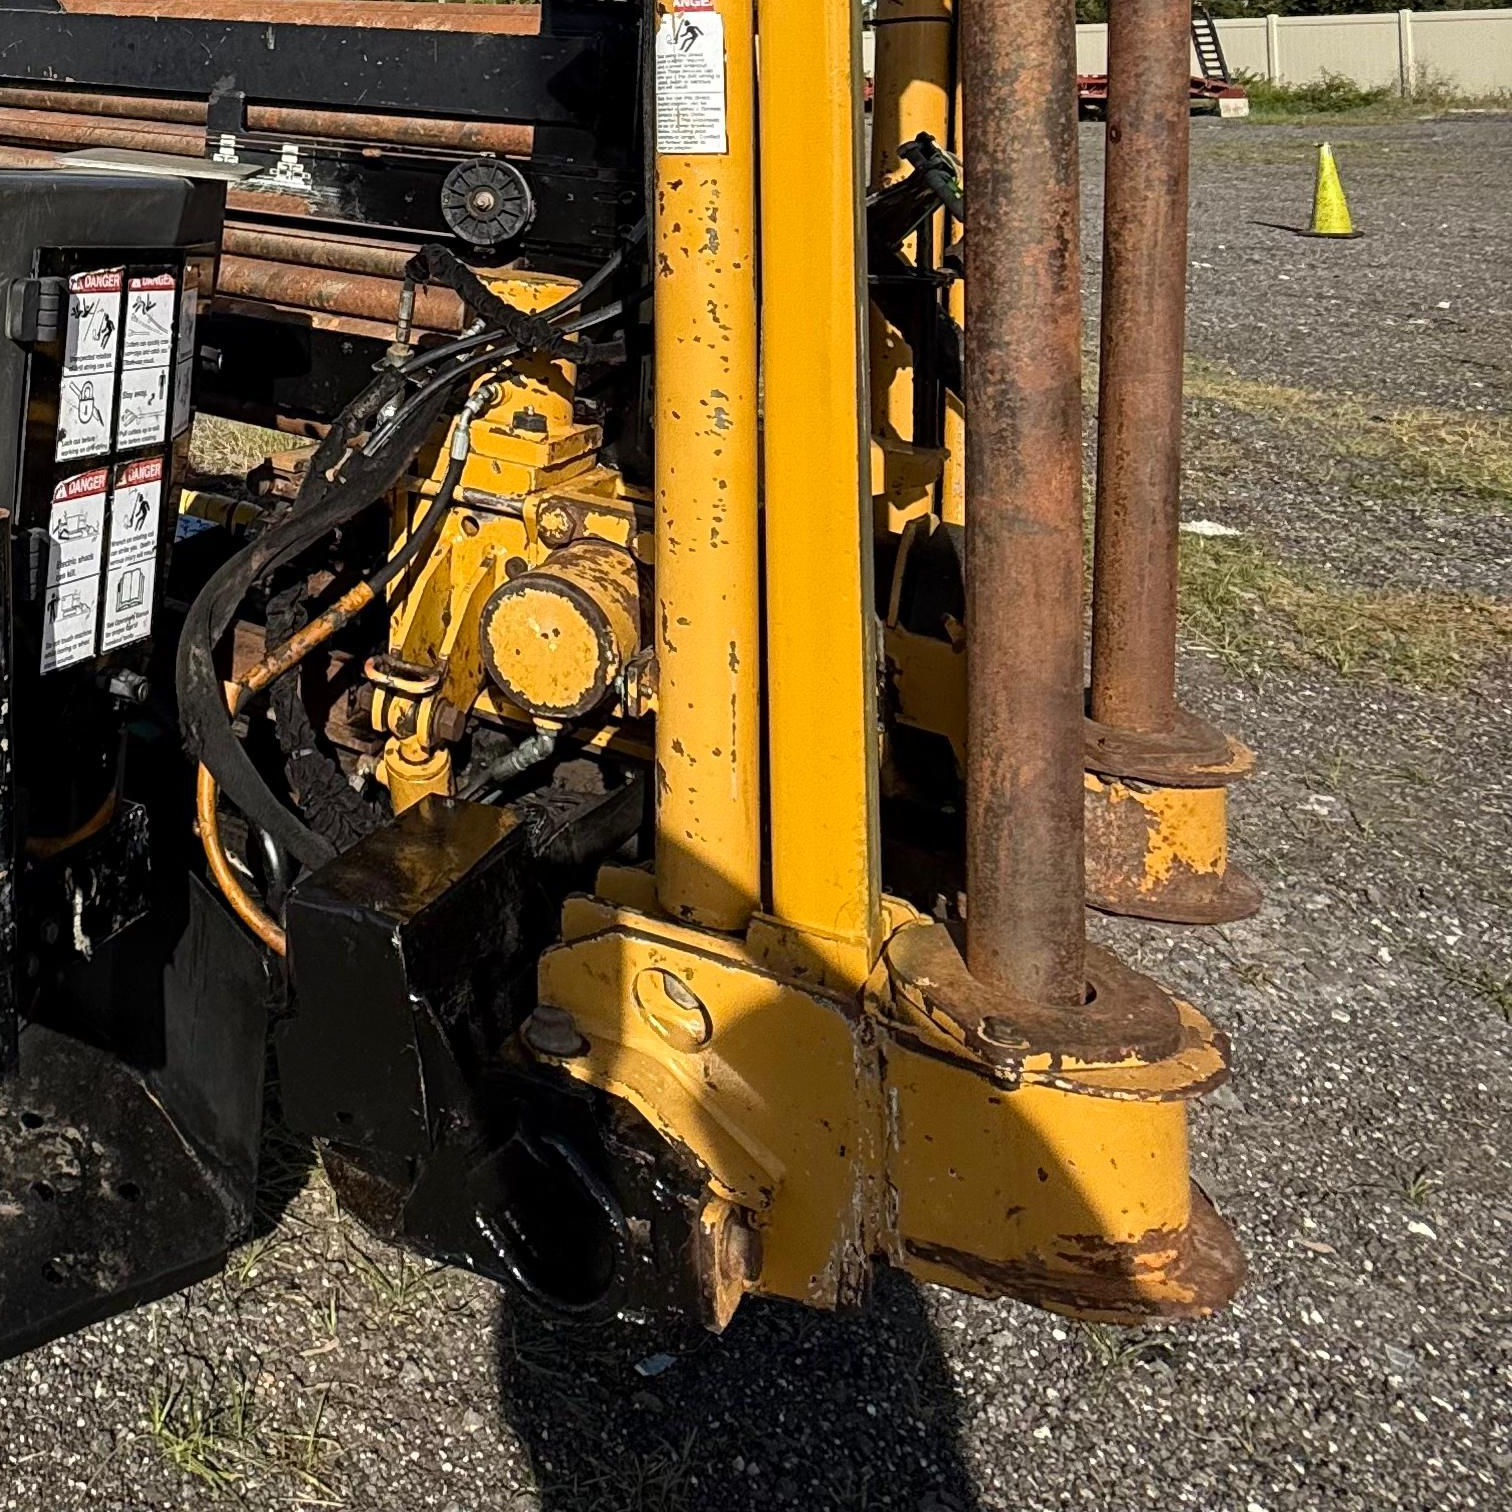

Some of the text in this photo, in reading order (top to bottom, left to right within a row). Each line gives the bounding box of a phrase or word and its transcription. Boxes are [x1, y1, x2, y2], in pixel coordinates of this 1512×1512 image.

[84, 273, 121, 288] DANGER
[142, 274, 175, 286] DANGER
[129, 463, 161, 481] DANGER
[68, 474, 105, 495] DANGER
